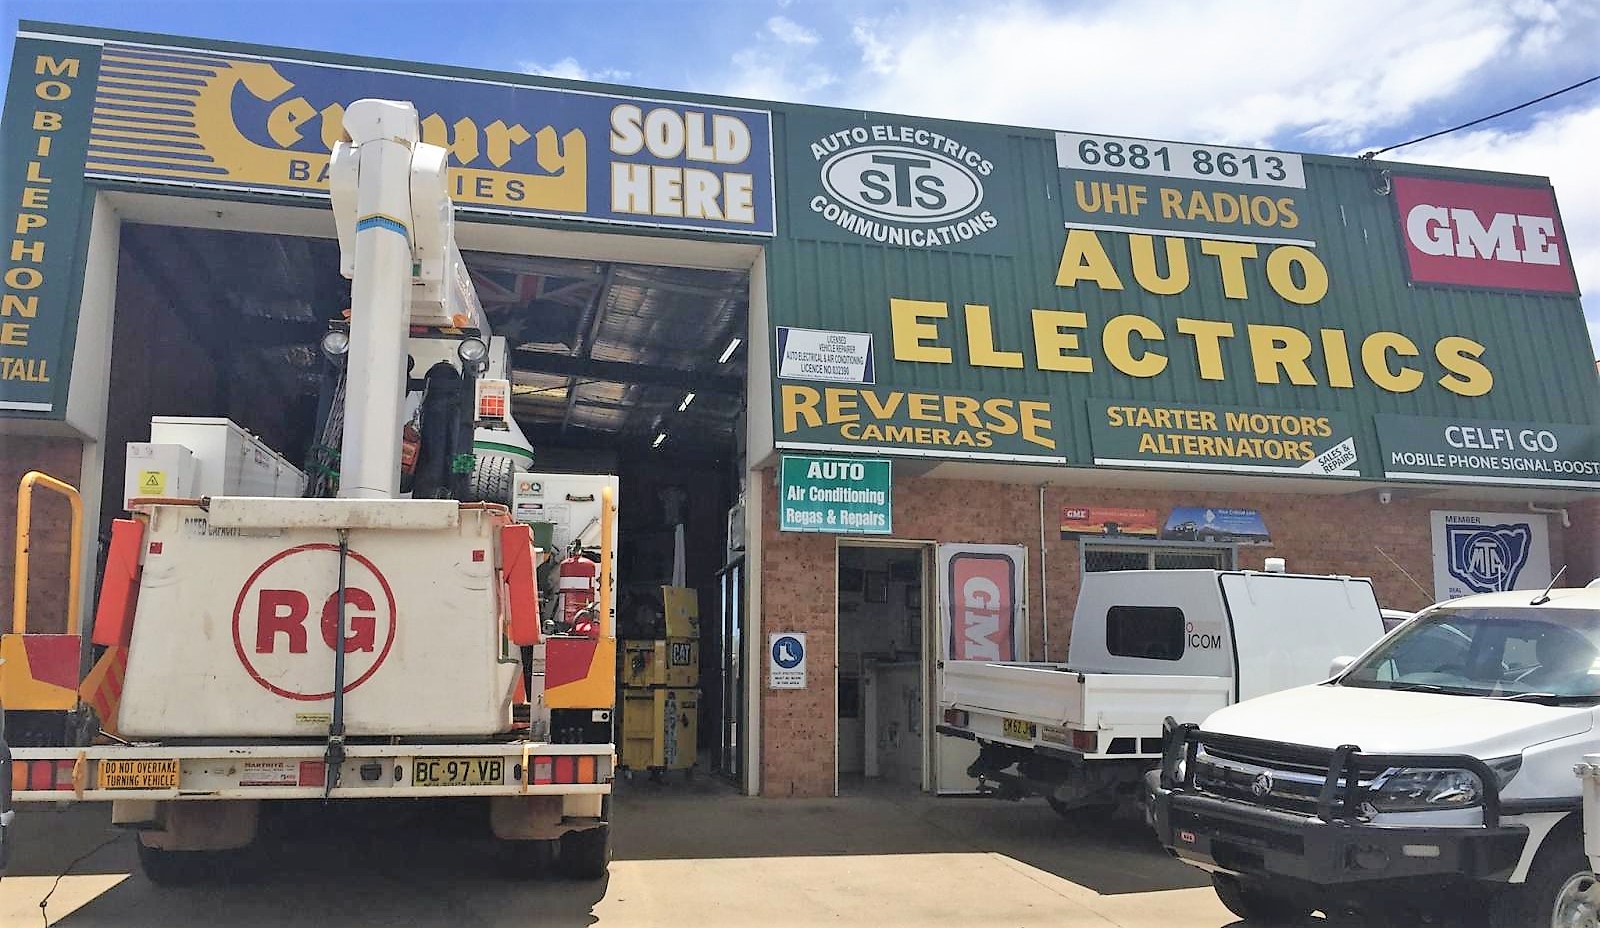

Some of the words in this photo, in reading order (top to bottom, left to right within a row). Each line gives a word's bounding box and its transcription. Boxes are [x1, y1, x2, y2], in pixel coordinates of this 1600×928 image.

[610, 104, 751, 165] SOLD
[810, 127, 868, 160] AUTO
[872, 125, 994, 176] ELECTRICS
[1079, 139, 1171, 172] 6881
[1193, 149, 1287, 181] 8613
[289, 159, 525, 202] BAIES
[610, 162, 756, 223] HERE
[1075, 180, 1148, 214] UHF
[1160, 187, 1299, 229] RADIOS
[810, 195, 998, 247] COMMUNICATIONS
[1407, 204, 1560, 265] GME
[1055, 229, 1329, 304] AUTO
[890, 298, 1494, 397] ELECTRICS
[801, 364, 822, 373] LICENCE
[781, 384, 1056, 450] REVERSE
[1106, 406, 1218, 431] STARTER
[1225, 412, 1333, 437] MOTORS
[840, 423, 993, 448] CAMERAS
[1138, 433, 1316, 461] ALTERNATORS
[1444, 426, 1514, 450] CELFI
[1519, 429, 1558, 453] GO
[807, 461, 864, 480] AUTO
[1318, 449, 1342, 467] SALES
[1341, 443, 1350, 453] &
[1323, 451, 1355, 473] REPAIRS
[1391, 452, 1446, 467] MOBILE
[1449, 455, 1500, 469] PHONE
[1502, 457, 1552, 472] SIGNAL
[787, 485, 806, 501] Air
[809, 486, 884, 505] Conditioning
[786, 508, 823, 525] Regas
[827, 509, 836, 525] &
[840, 510, 885, 527] Repairs
[256, 587, 377, 654] RG
[964, 576, 1000, 661] GM
[673, 643, 690, 664] CAT
[105, 762, 115, 774] DO
[119, 762, 134, 774] NOT
[137, 761, 176, 774] OVERTAKE
[106, 774, 139, 786] TURNING
[142, 774, 176, 786] VEHICLE
